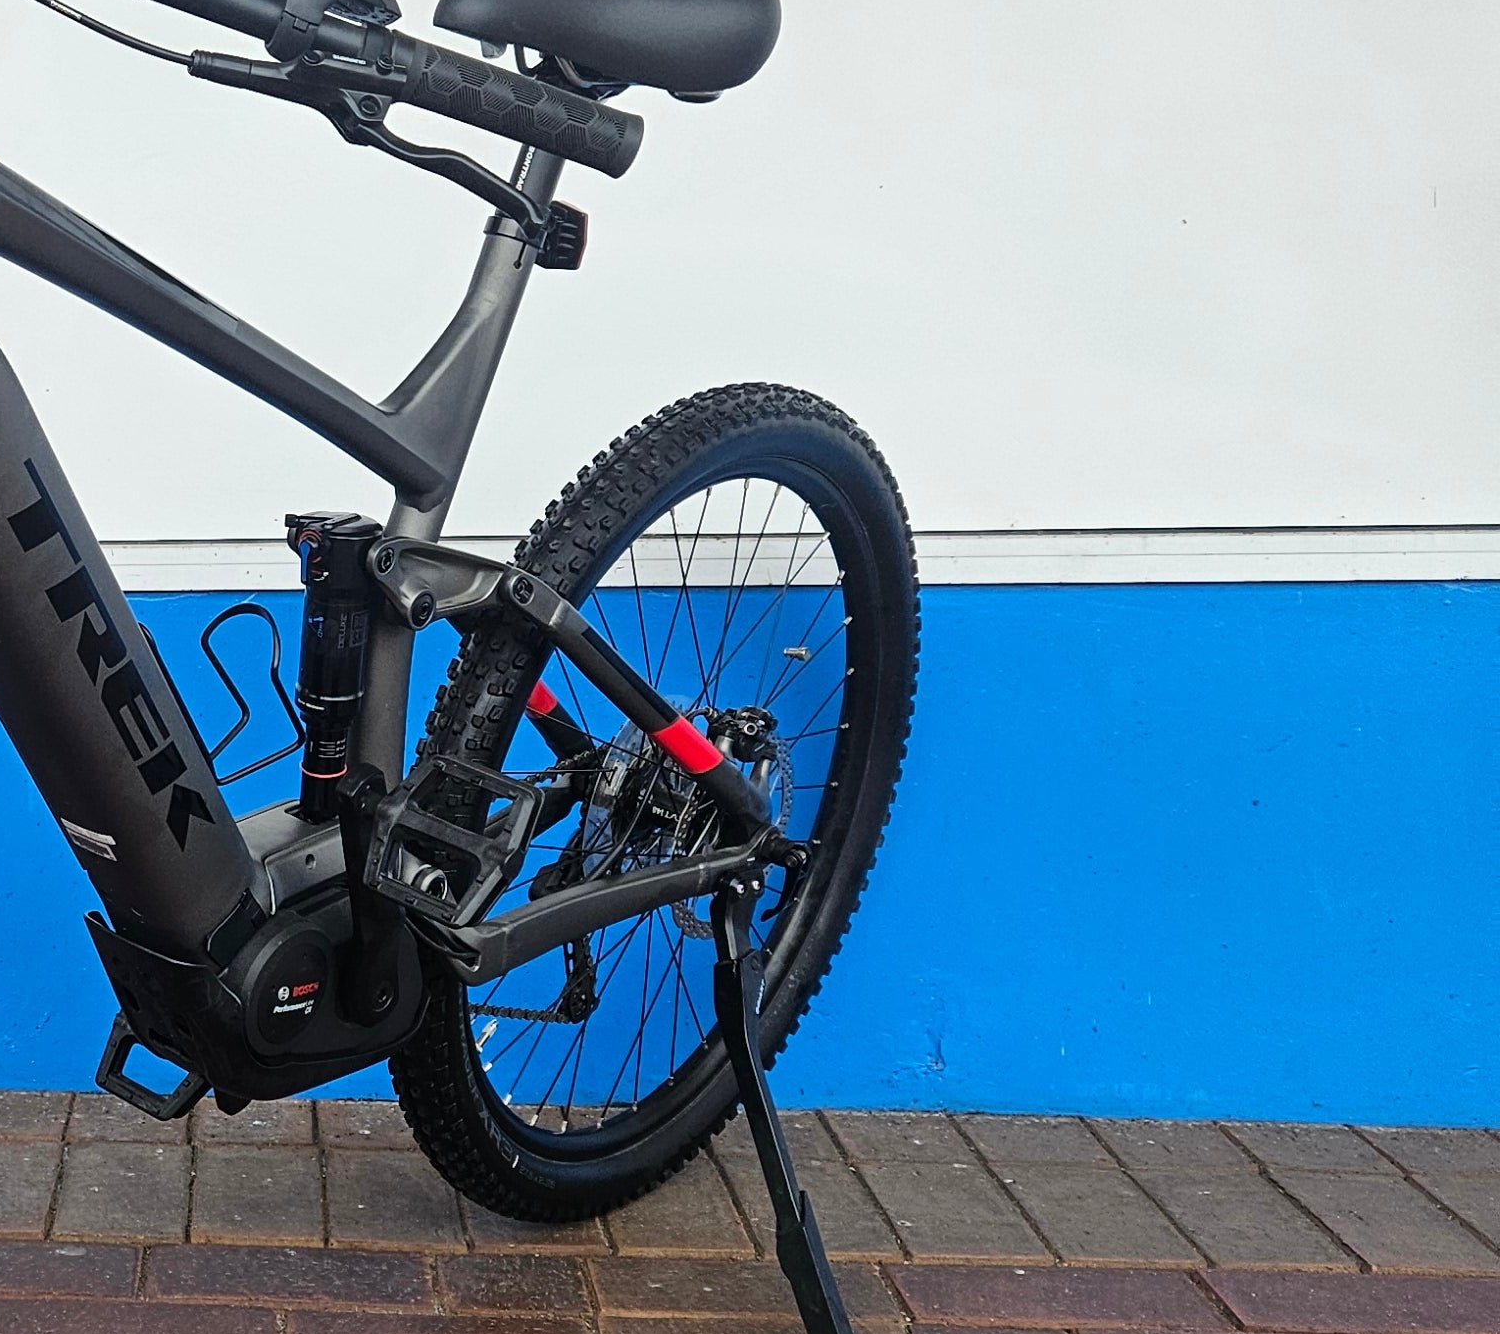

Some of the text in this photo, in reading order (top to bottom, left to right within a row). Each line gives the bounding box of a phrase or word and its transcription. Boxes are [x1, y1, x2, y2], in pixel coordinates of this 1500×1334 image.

[515, 145, 536, 192] BONTRAG
[6, 457, 216, 853] TREK
[292, 980, 320, 998] BOSCH
